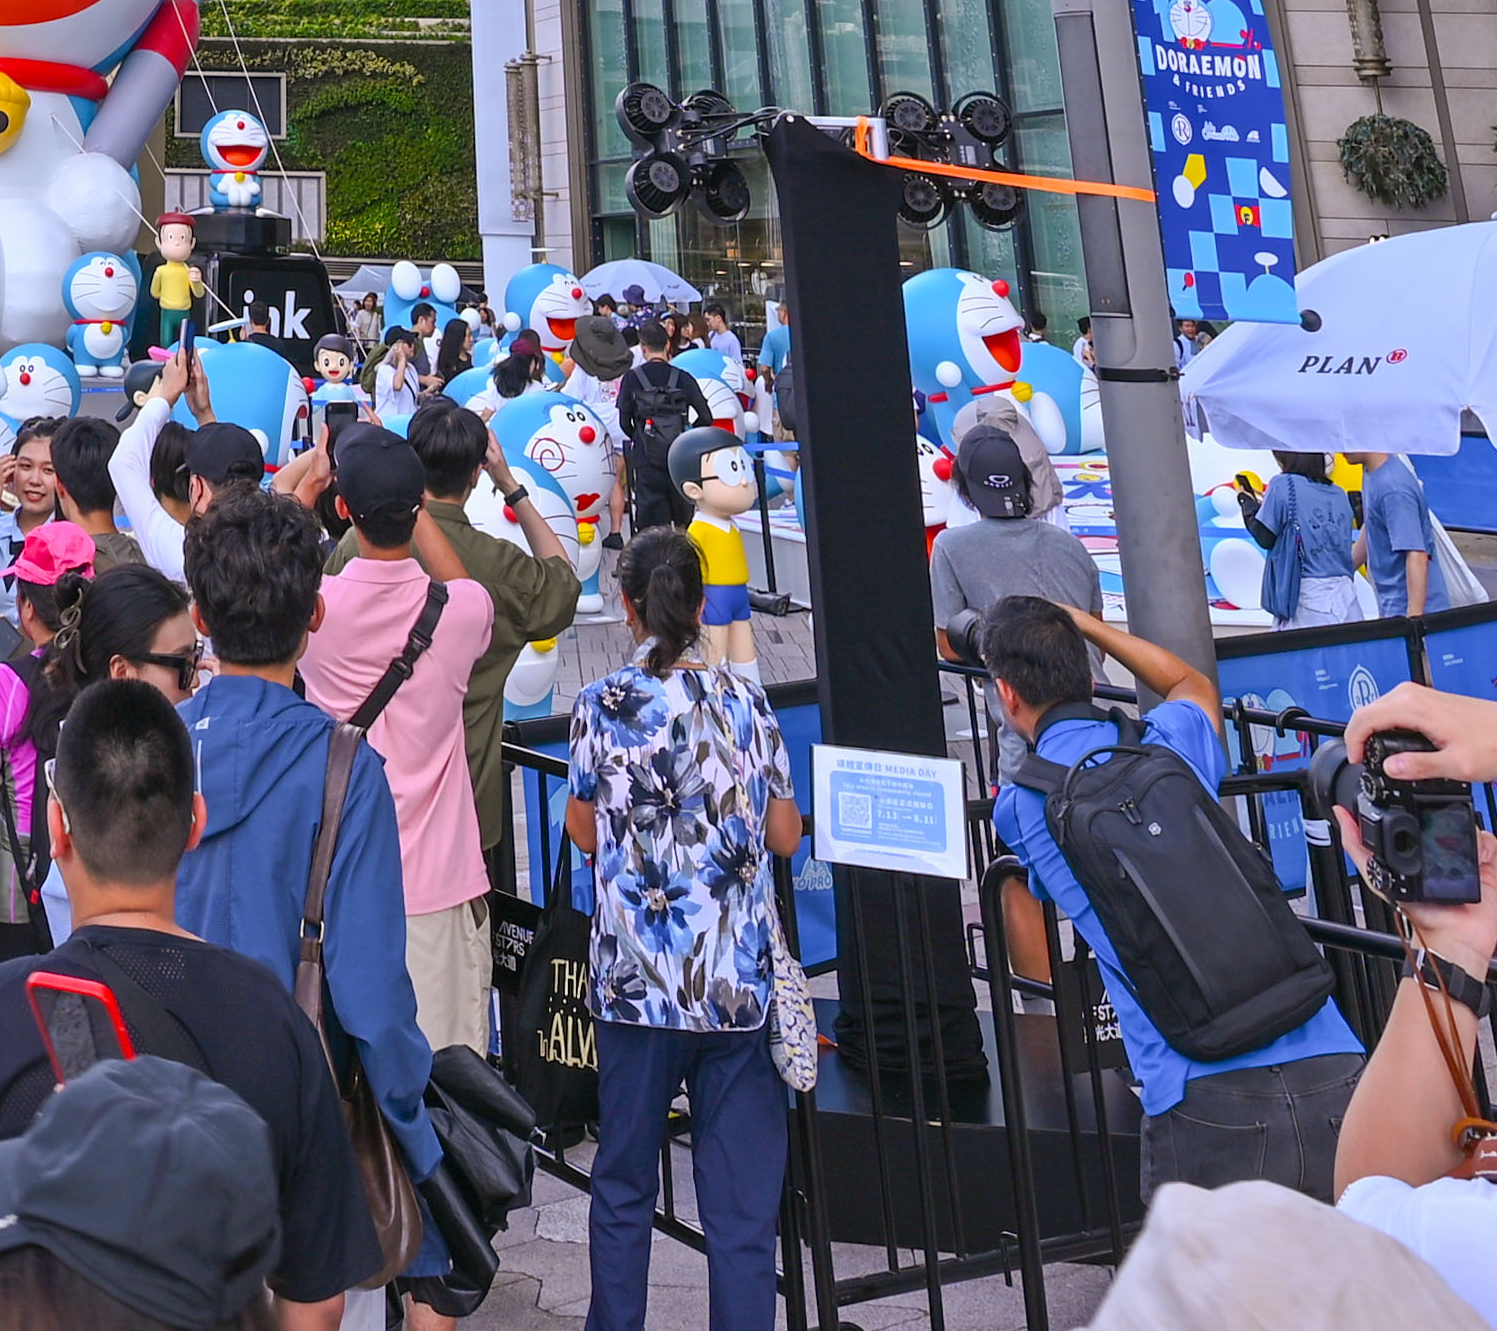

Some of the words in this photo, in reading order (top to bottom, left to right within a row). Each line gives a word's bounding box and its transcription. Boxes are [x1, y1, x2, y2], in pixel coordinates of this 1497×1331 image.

[1155, 44, 1262, 80] DORAEMON
[1185, 79, 1246, 99] FRIENDS
[1298, 355, 1382, 375] PLAN
[884, 763, 916, 778] MEDIA
[917, 767, 937, 779] DAY
[499, 920, 536, 945] AVENUE
